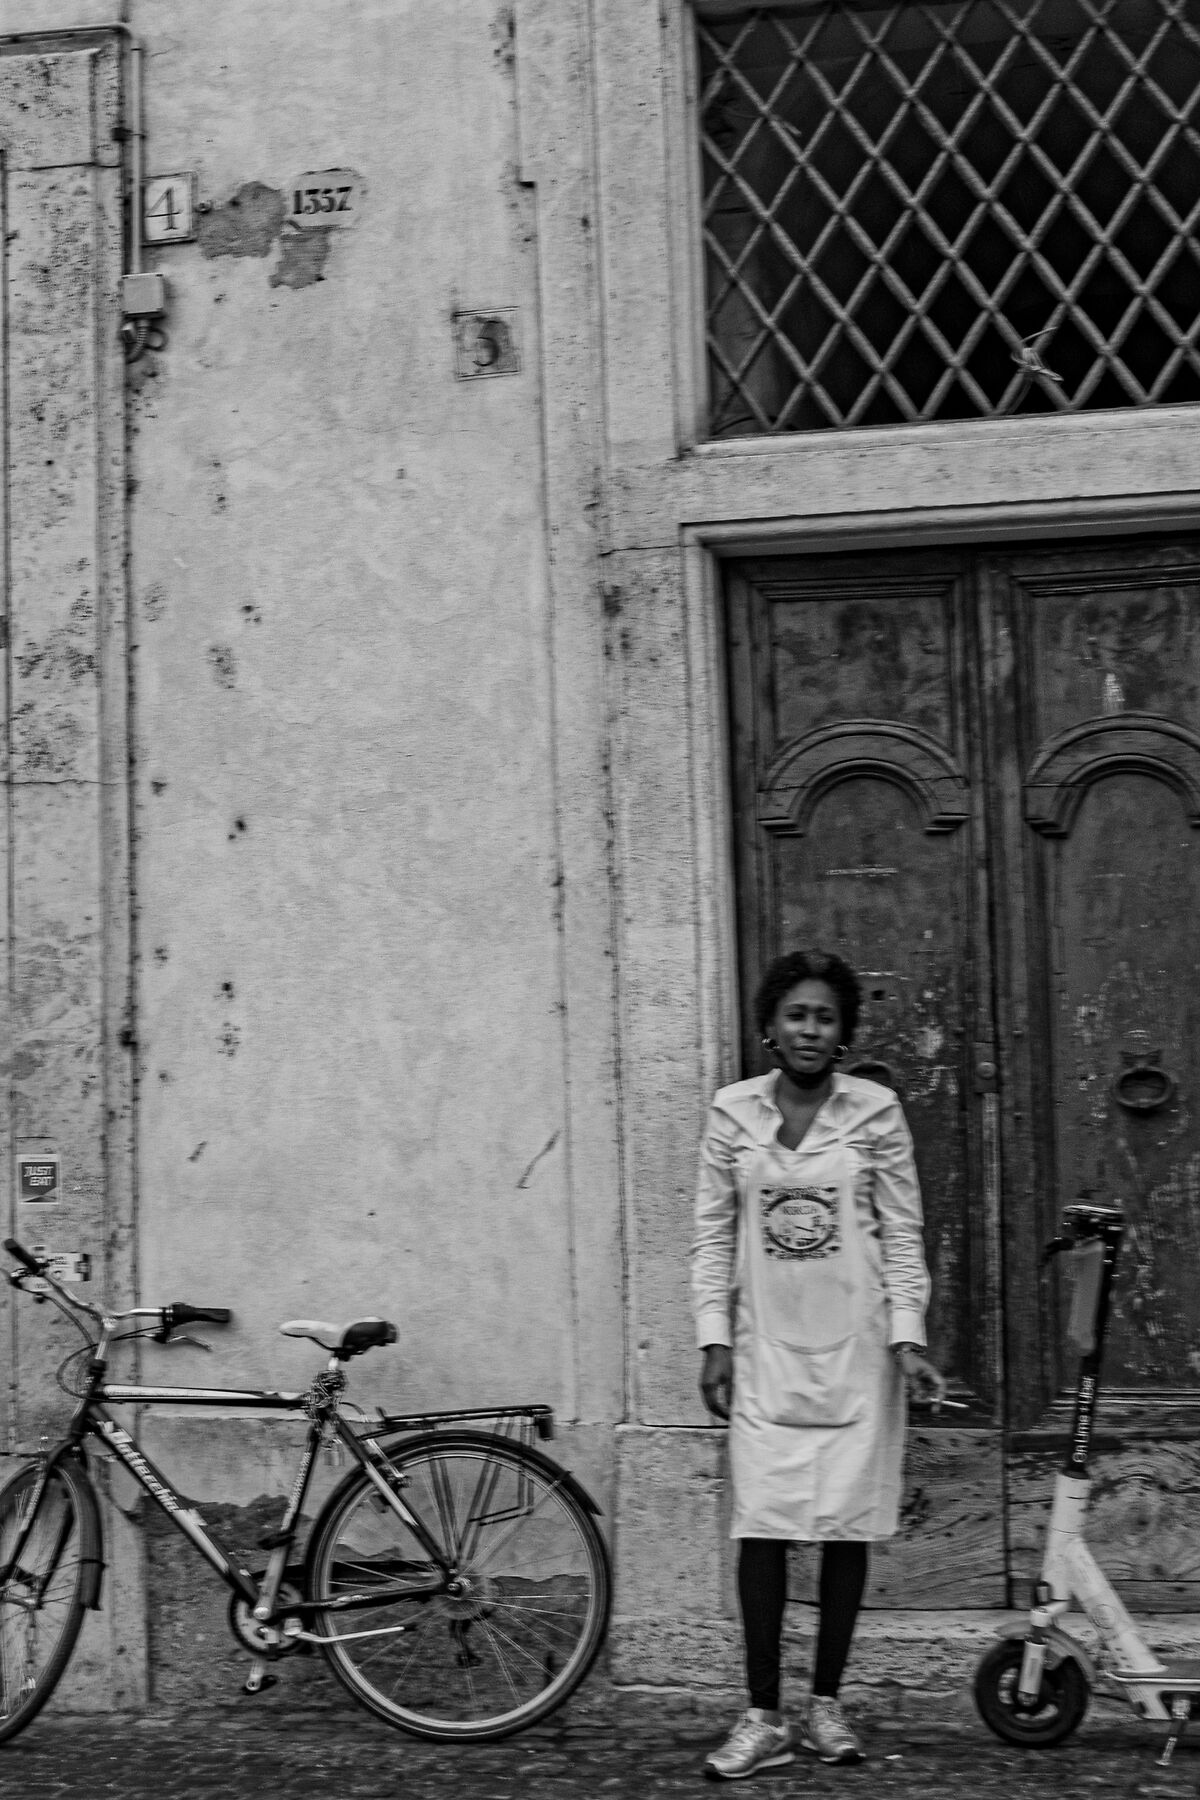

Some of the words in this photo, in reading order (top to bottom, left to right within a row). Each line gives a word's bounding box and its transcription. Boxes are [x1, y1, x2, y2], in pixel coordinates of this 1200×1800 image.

[144, 187, 182, 230] 4
[23, 1166, 54, 1177] JUST
[29, 1176, 54, 1186] EAT
[1078, 1376, 1096, 1404] Uber
[1073, 1413, 1090, 1443] Lime
[1072, 1445, 1089, 1463] On
